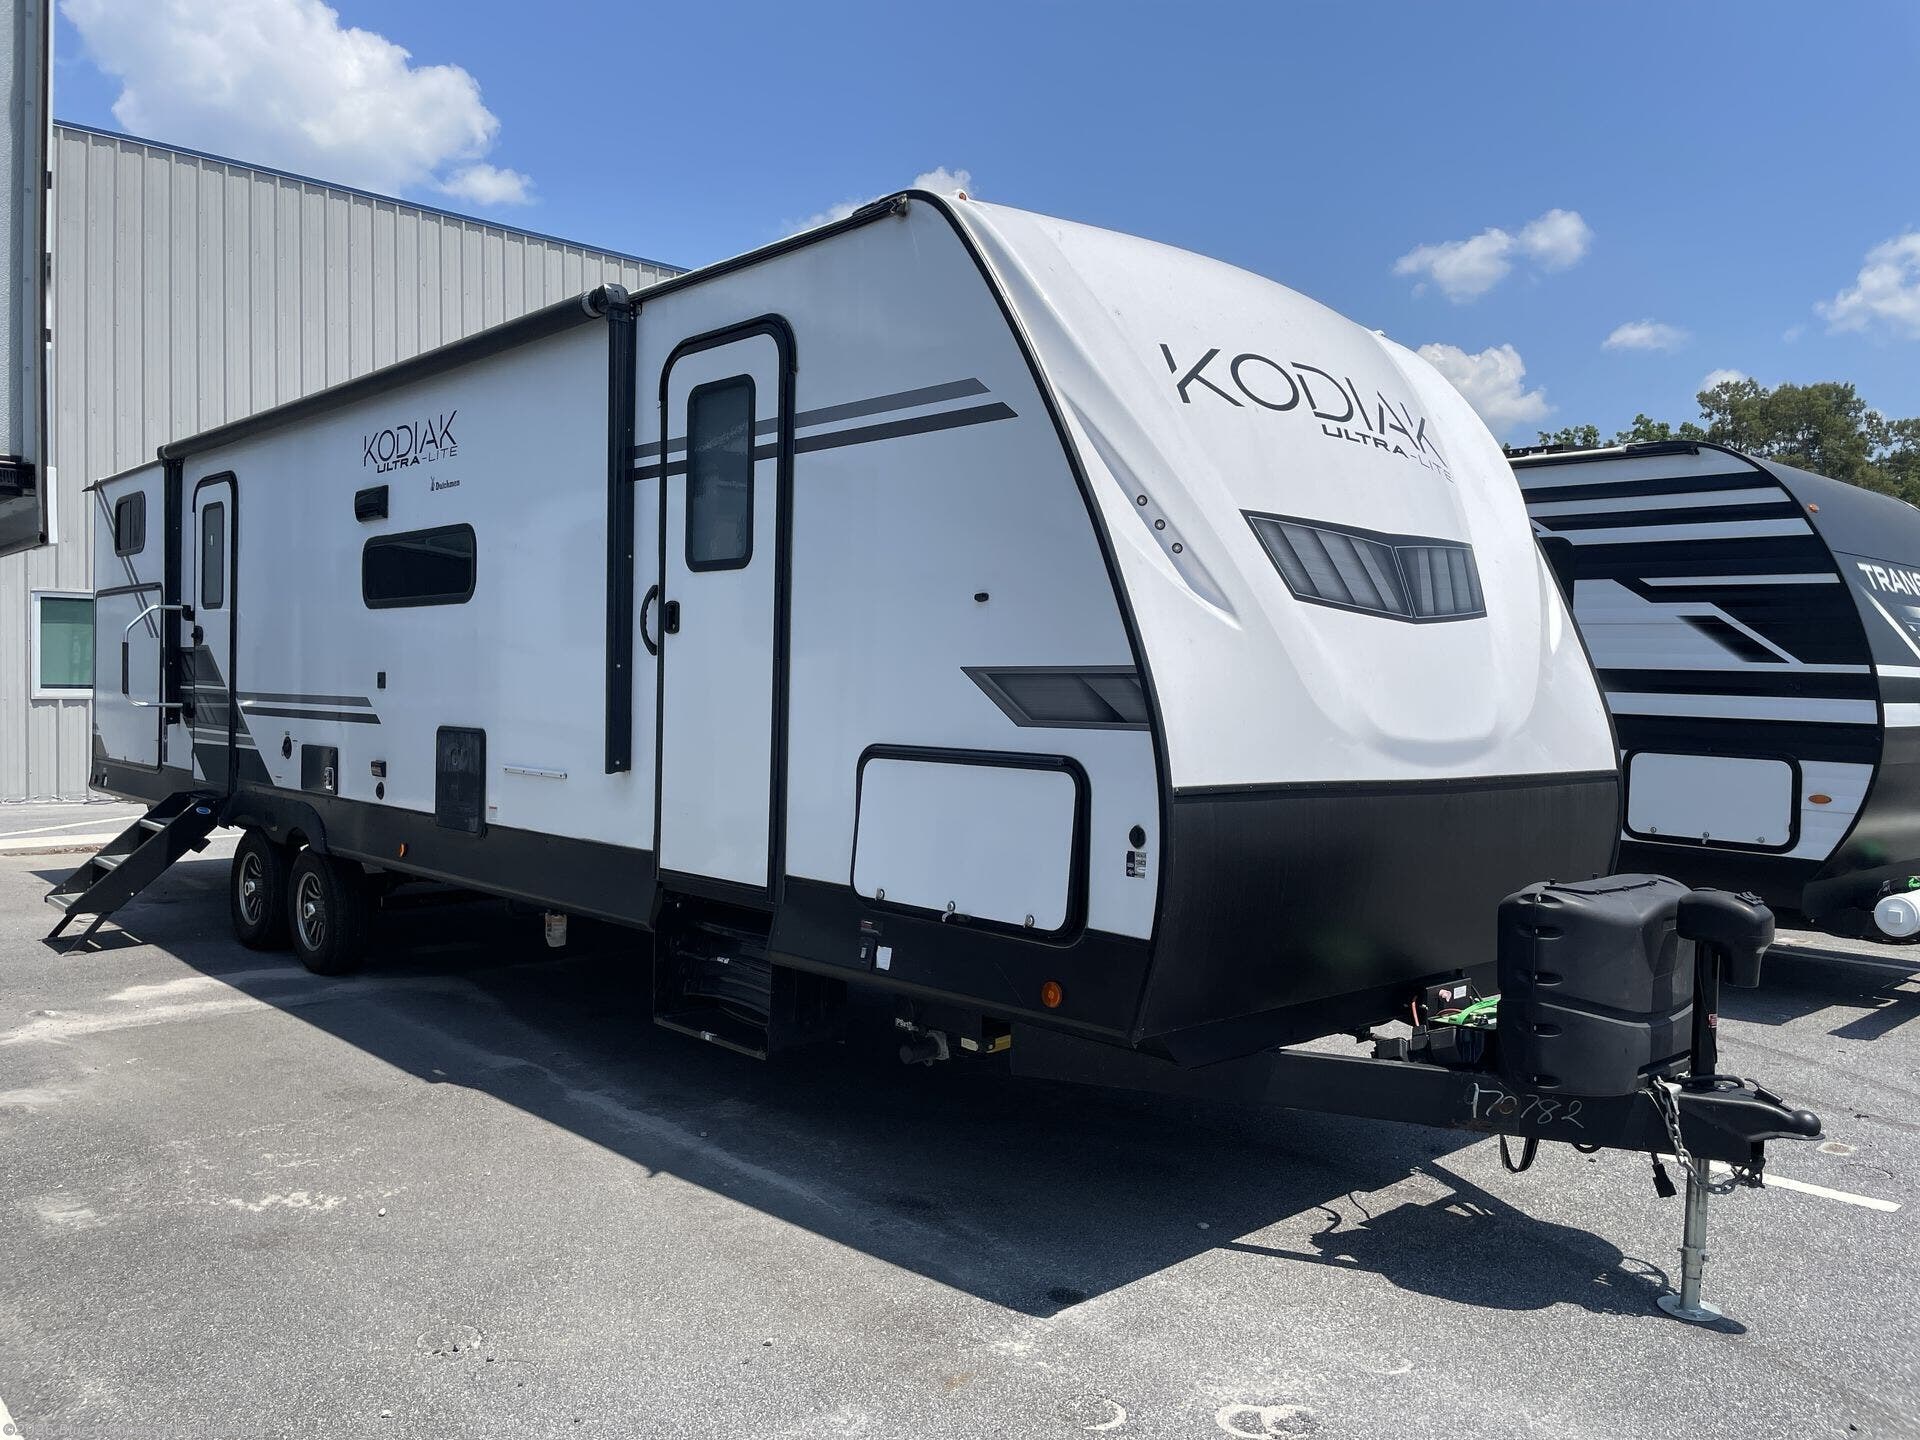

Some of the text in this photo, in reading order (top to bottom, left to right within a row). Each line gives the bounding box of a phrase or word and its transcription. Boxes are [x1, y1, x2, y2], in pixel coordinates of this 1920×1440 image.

[1159, 343, 1448, 468] KODIAK
[363, 409, 458, 467] KODIAK
[376, 445, 458, 473] ULTRA-LITE
[1321, 423, 1456, 484] ULTRA-LITE
